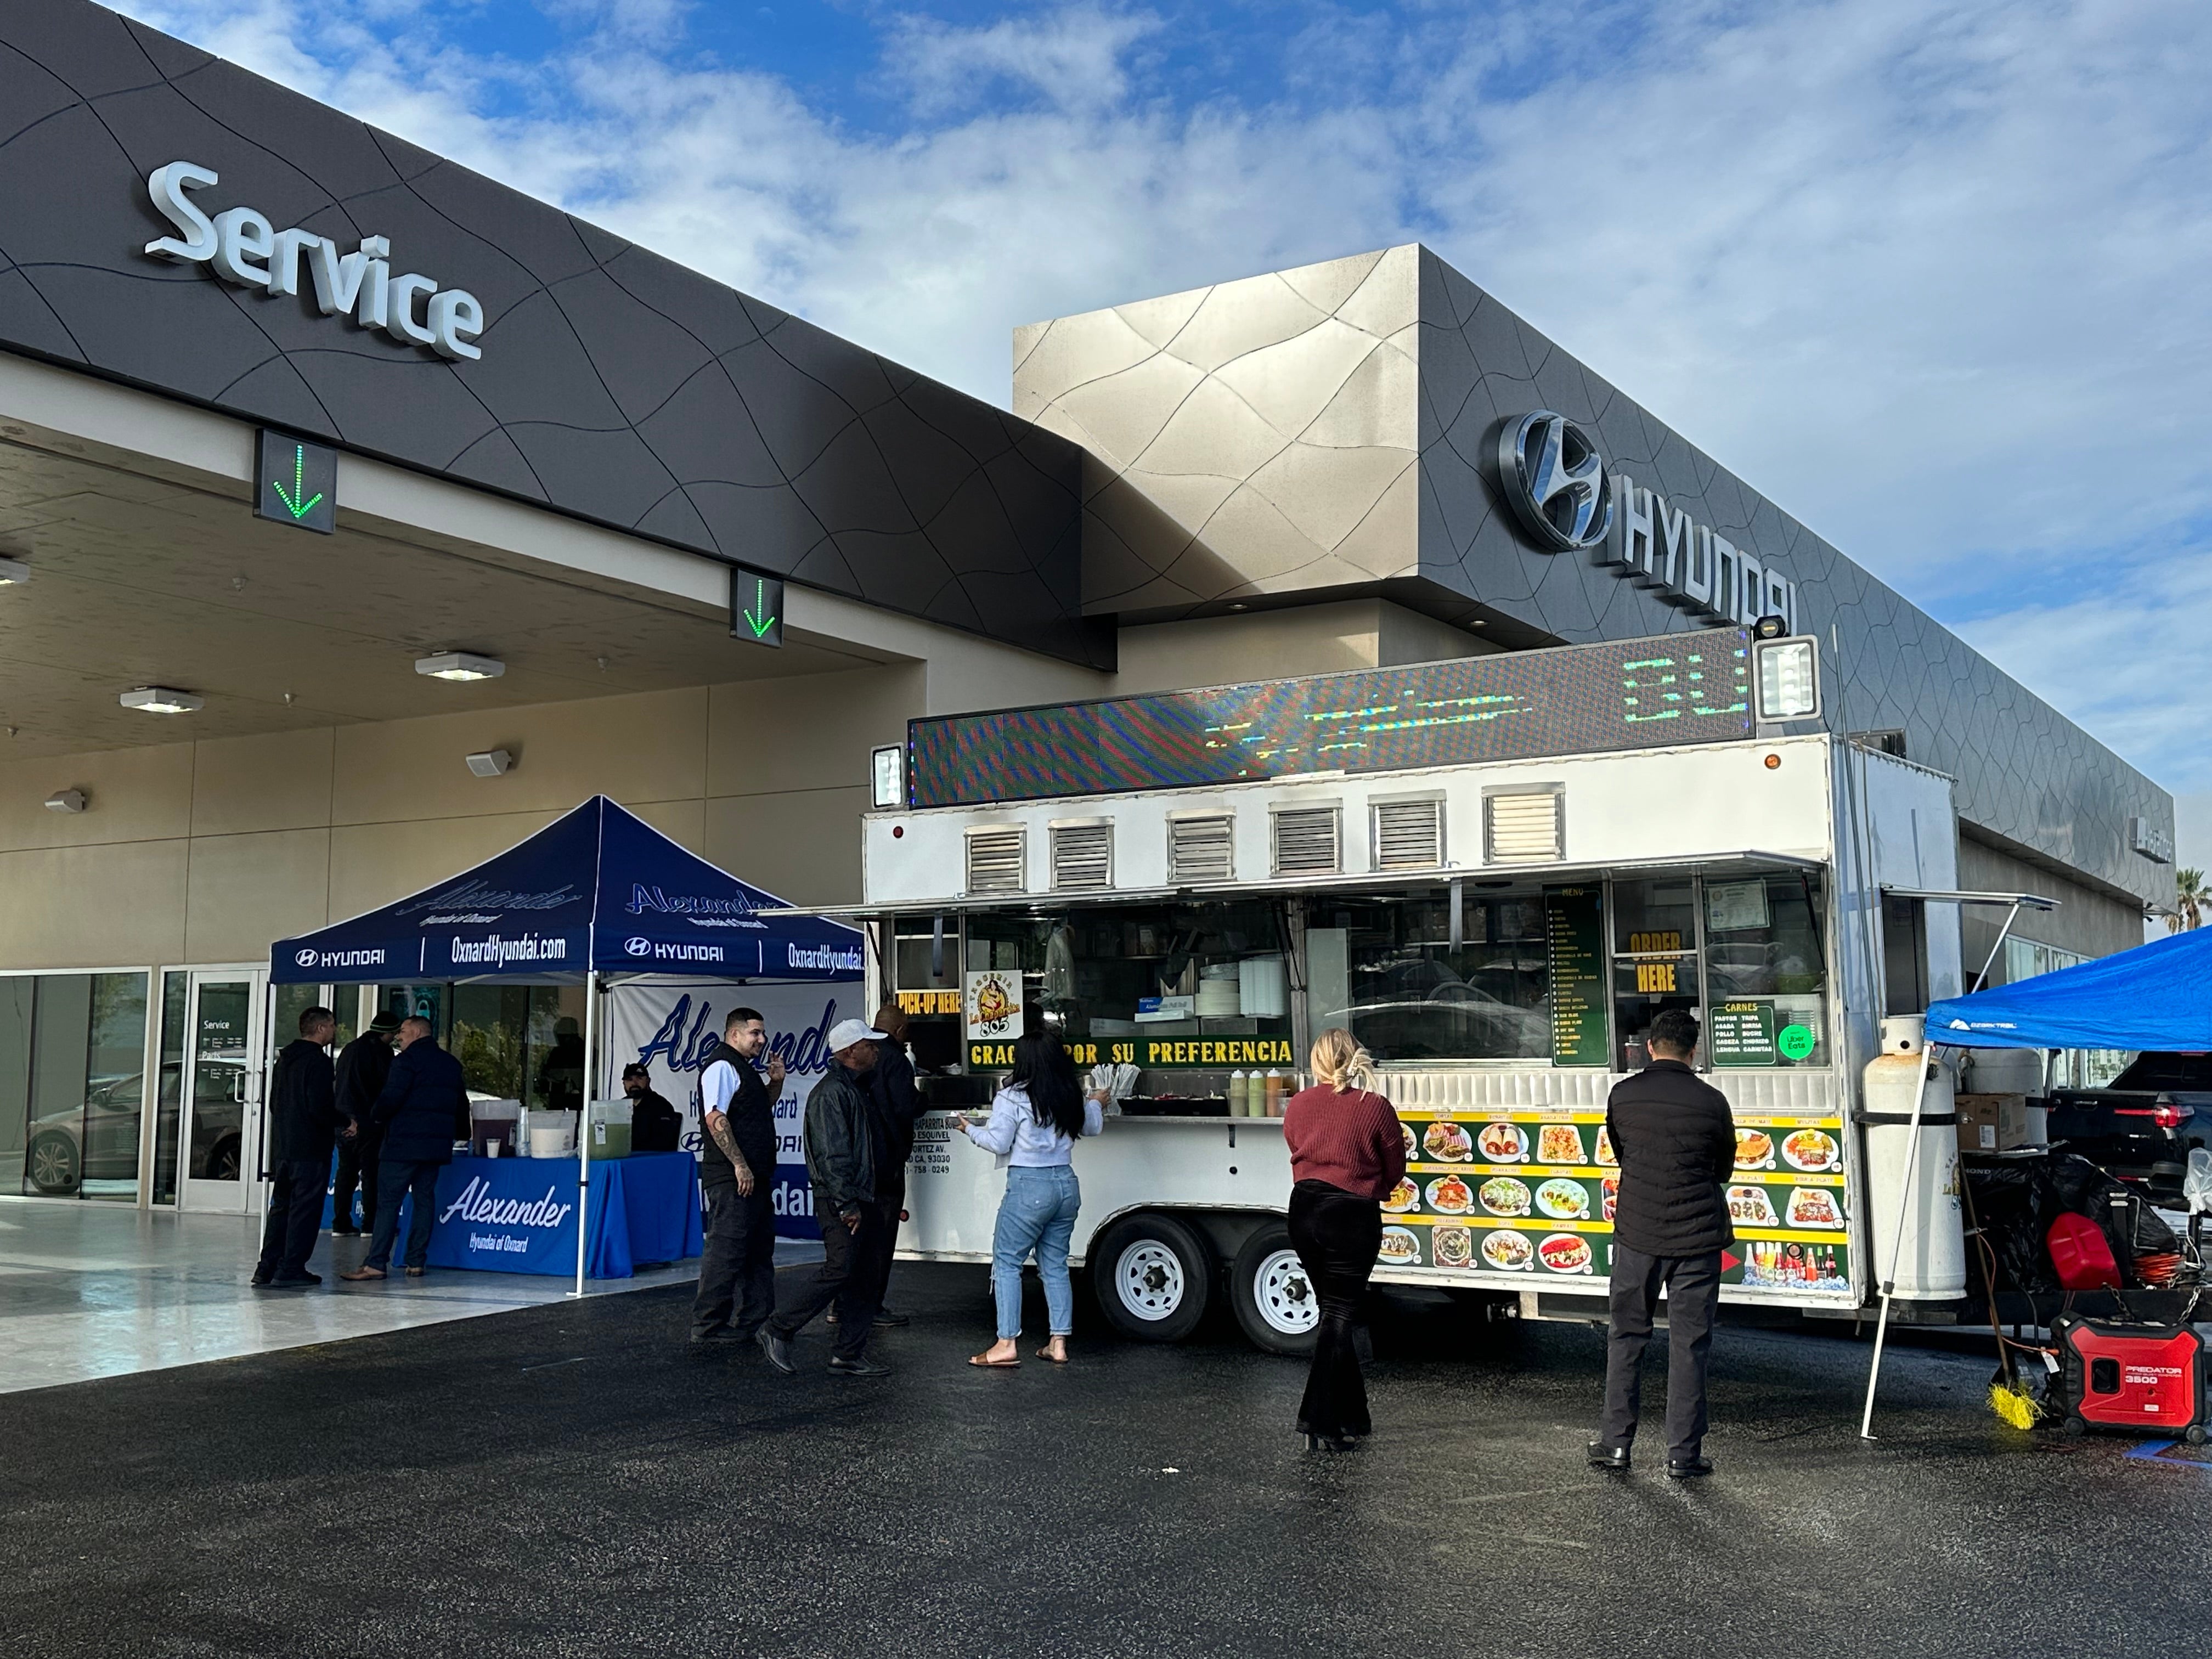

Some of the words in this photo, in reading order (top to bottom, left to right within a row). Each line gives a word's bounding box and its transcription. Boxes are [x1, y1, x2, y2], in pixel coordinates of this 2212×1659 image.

[145, 161, 484, 362] Service
[1613, 474, 1797, 637] HYUNDAI
[1562, 888, 1583, 896] MENU
[321, 949, 384, 967] HYUNDAI
[452, 933, 566, 968] OxnardHyundai.com
[1630, 932, 1681, 961] ORDER
[654, 943, 724, 962] HYUNDAI
[789, 942, 865, 975] OxnardHyundai.
[1637, 963, 1677, 992] HERE
[899, 992, 936, 1014] PICK-UP
[938, 992, 961, 1014] HERE
[1725, 1003, 1758, 1012] CARNES
[204, 1020, 230, 1029] Service
[980, 1016, 1009, 1037] 805
[202, 1051, 221, 1060] Parts
[971, 1045, 1015, 1064] GRAC
[1112, 1043, 1134, 1063] SU
[1148, 1040, 1293, 1063] PREFERENCIA
[918, 1131, 950, 1140] ESQUIVEL
[912, 1144, 934, 1153] ORTEZ
[928, 1155, 950, 1163] 93030
[932, 1165, 949, 1174] 0249
[439, 1176, 571, 1228] Alexander
[470, 1233, 495, 1253] Hyundai
[495, 1235, 505, 1250] of
[503, 1235, 529, 1252] Oxnard
[2125, 1365, 2182, 1374] PREDATOR
